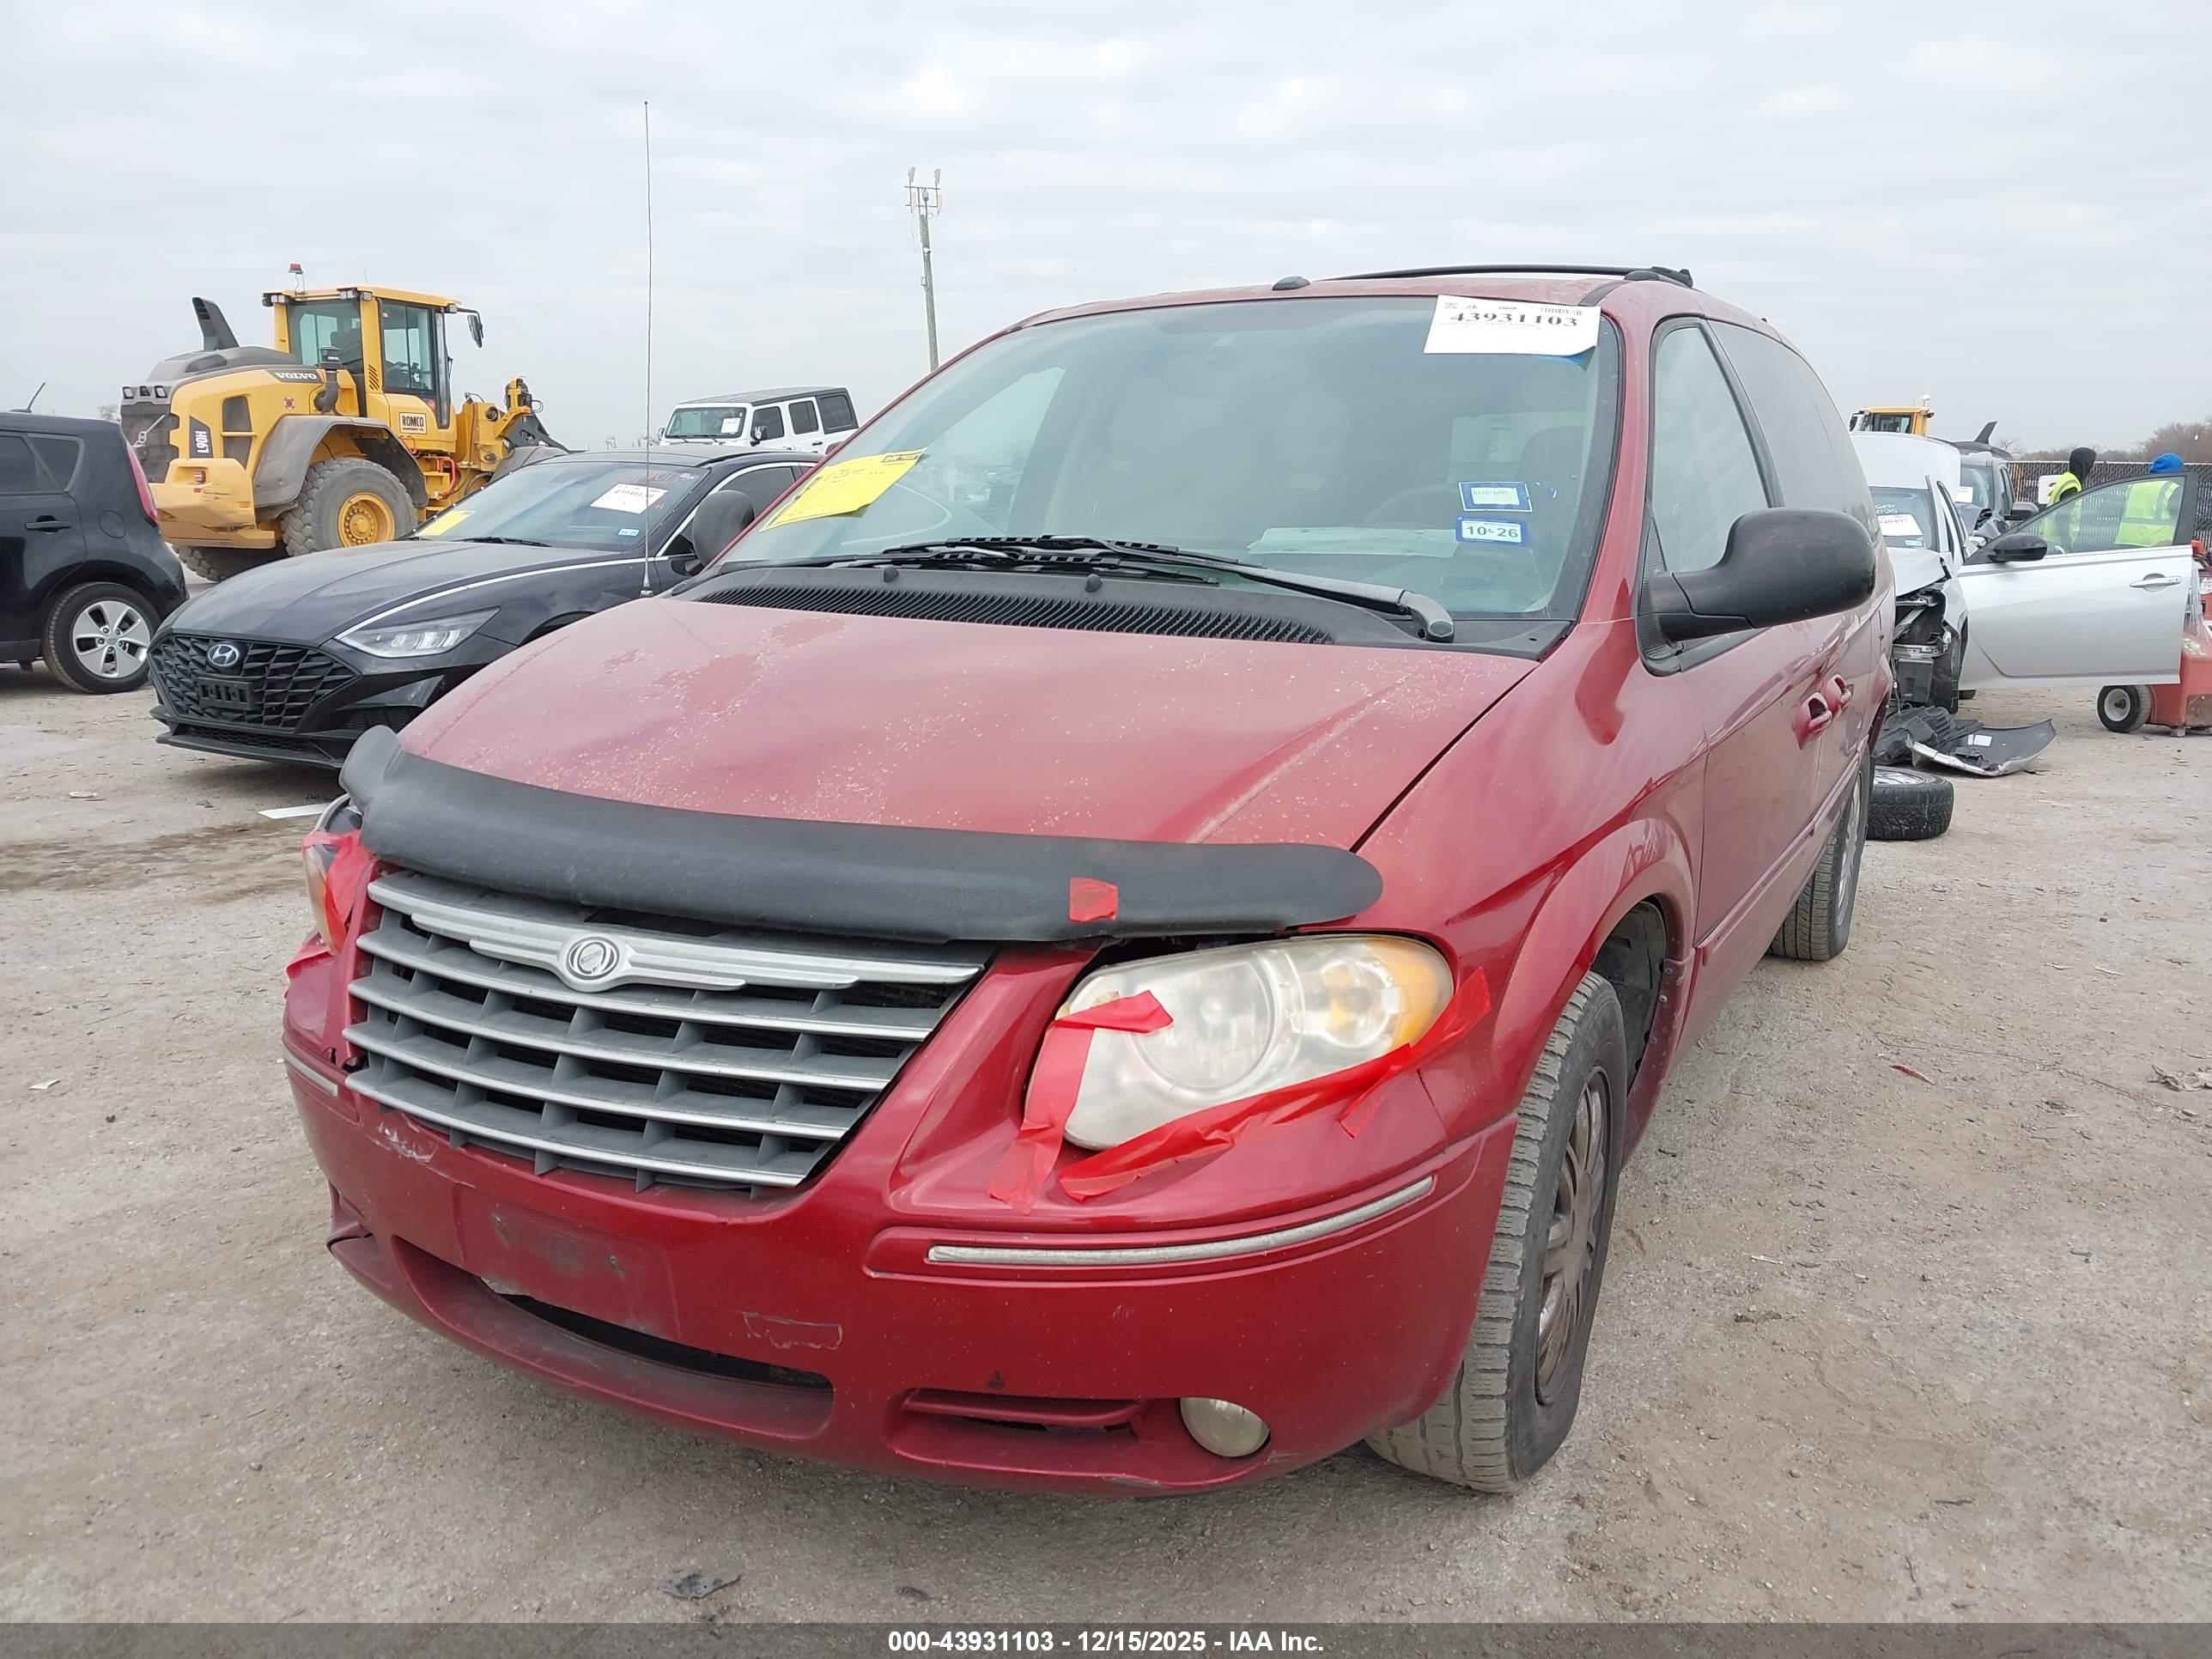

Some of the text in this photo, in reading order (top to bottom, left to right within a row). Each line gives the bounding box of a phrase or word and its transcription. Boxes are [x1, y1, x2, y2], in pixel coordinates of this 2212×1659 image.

[1450, 312, 1577, 327] 43931103
[274, 372, 317, 380] VOLVO
[402, 415, 424, 428] ROMCO
[194, 430, 210, 453] L90H
[1466, 526, 1518, 538] 10 26
